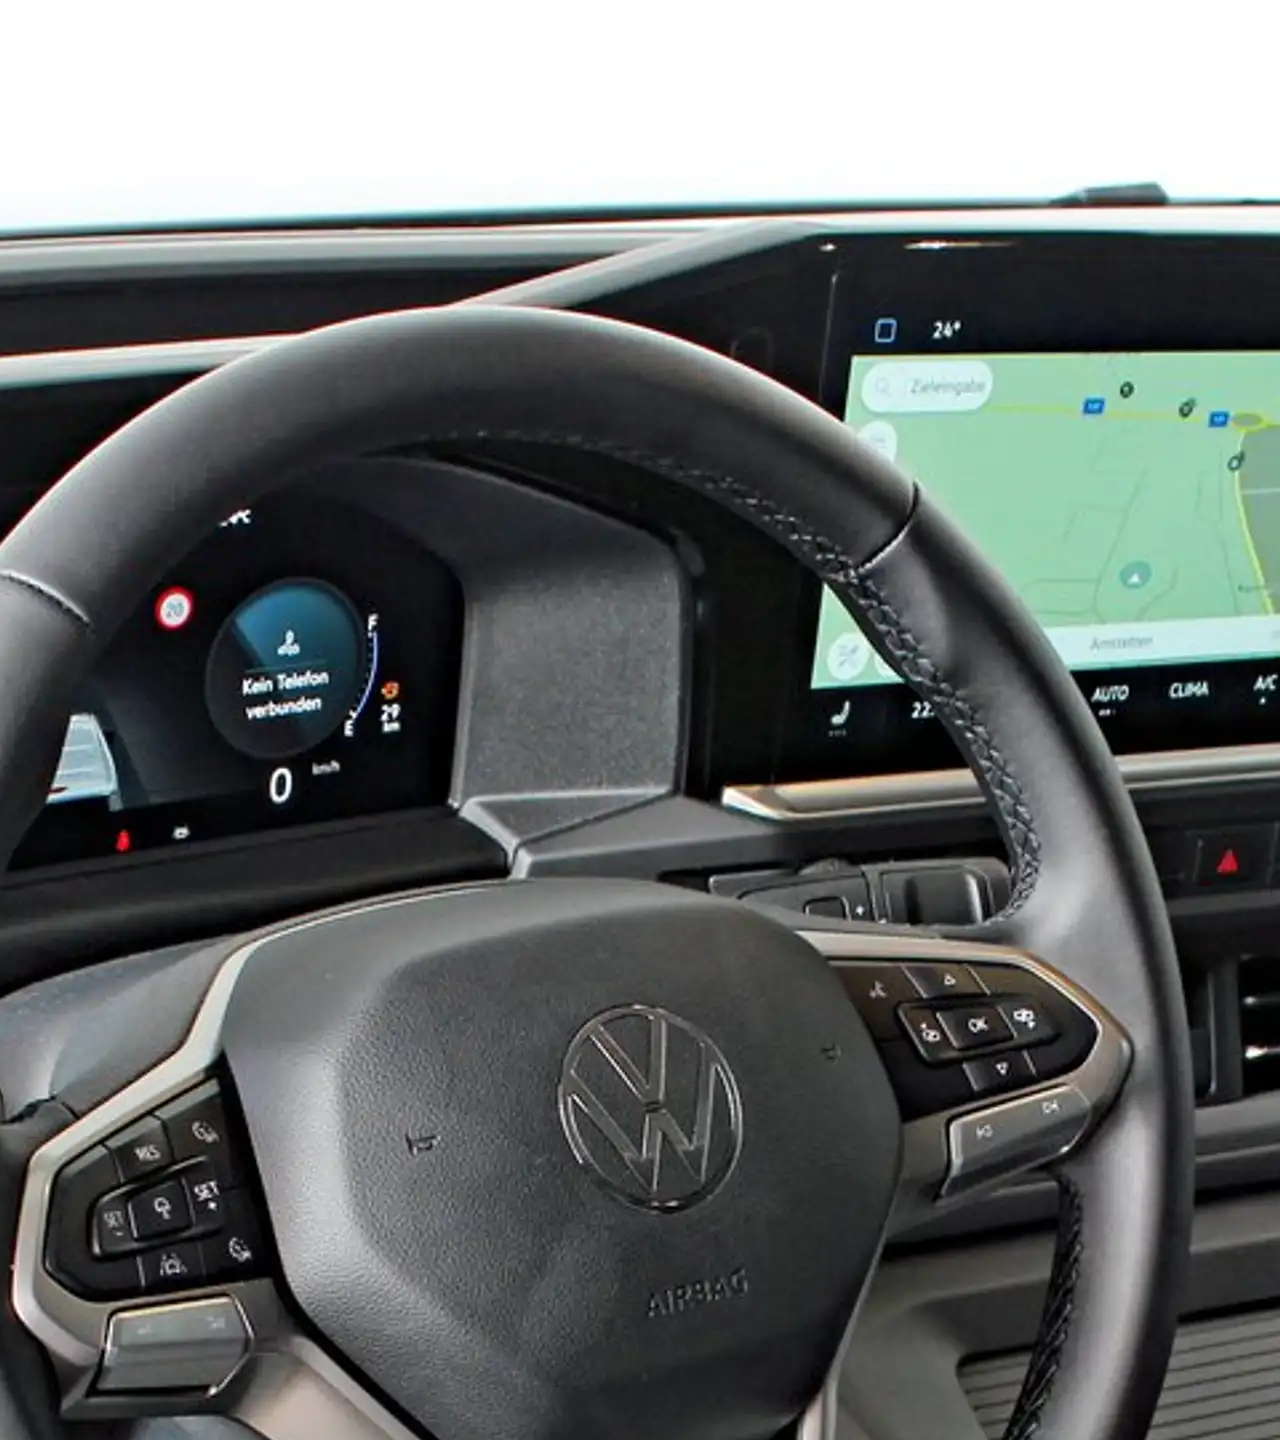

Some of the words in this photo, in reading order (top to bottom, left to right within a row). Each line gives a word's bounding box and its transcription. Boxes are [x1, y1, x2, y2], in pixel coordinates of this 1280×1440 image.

[369, 614, 379, 632] F
[242, 676, 273, 697] Kein
[277, 670, 329, 691] Telefon
[1169, 680, 1209, 701] CLIMA
[1254, 674, 1279, 692] A/C
[1091, 684, 1130, 704] AUTO
[246, 696, 322, 721] verbunden
[381, 704, 401, 721] 29
[344, 718, 356, 737] E
[268, 766, 293, 804] 0
[193, 1181, 220, 1202] SET
[646, 1268, 749, 1318] AIRBAG
